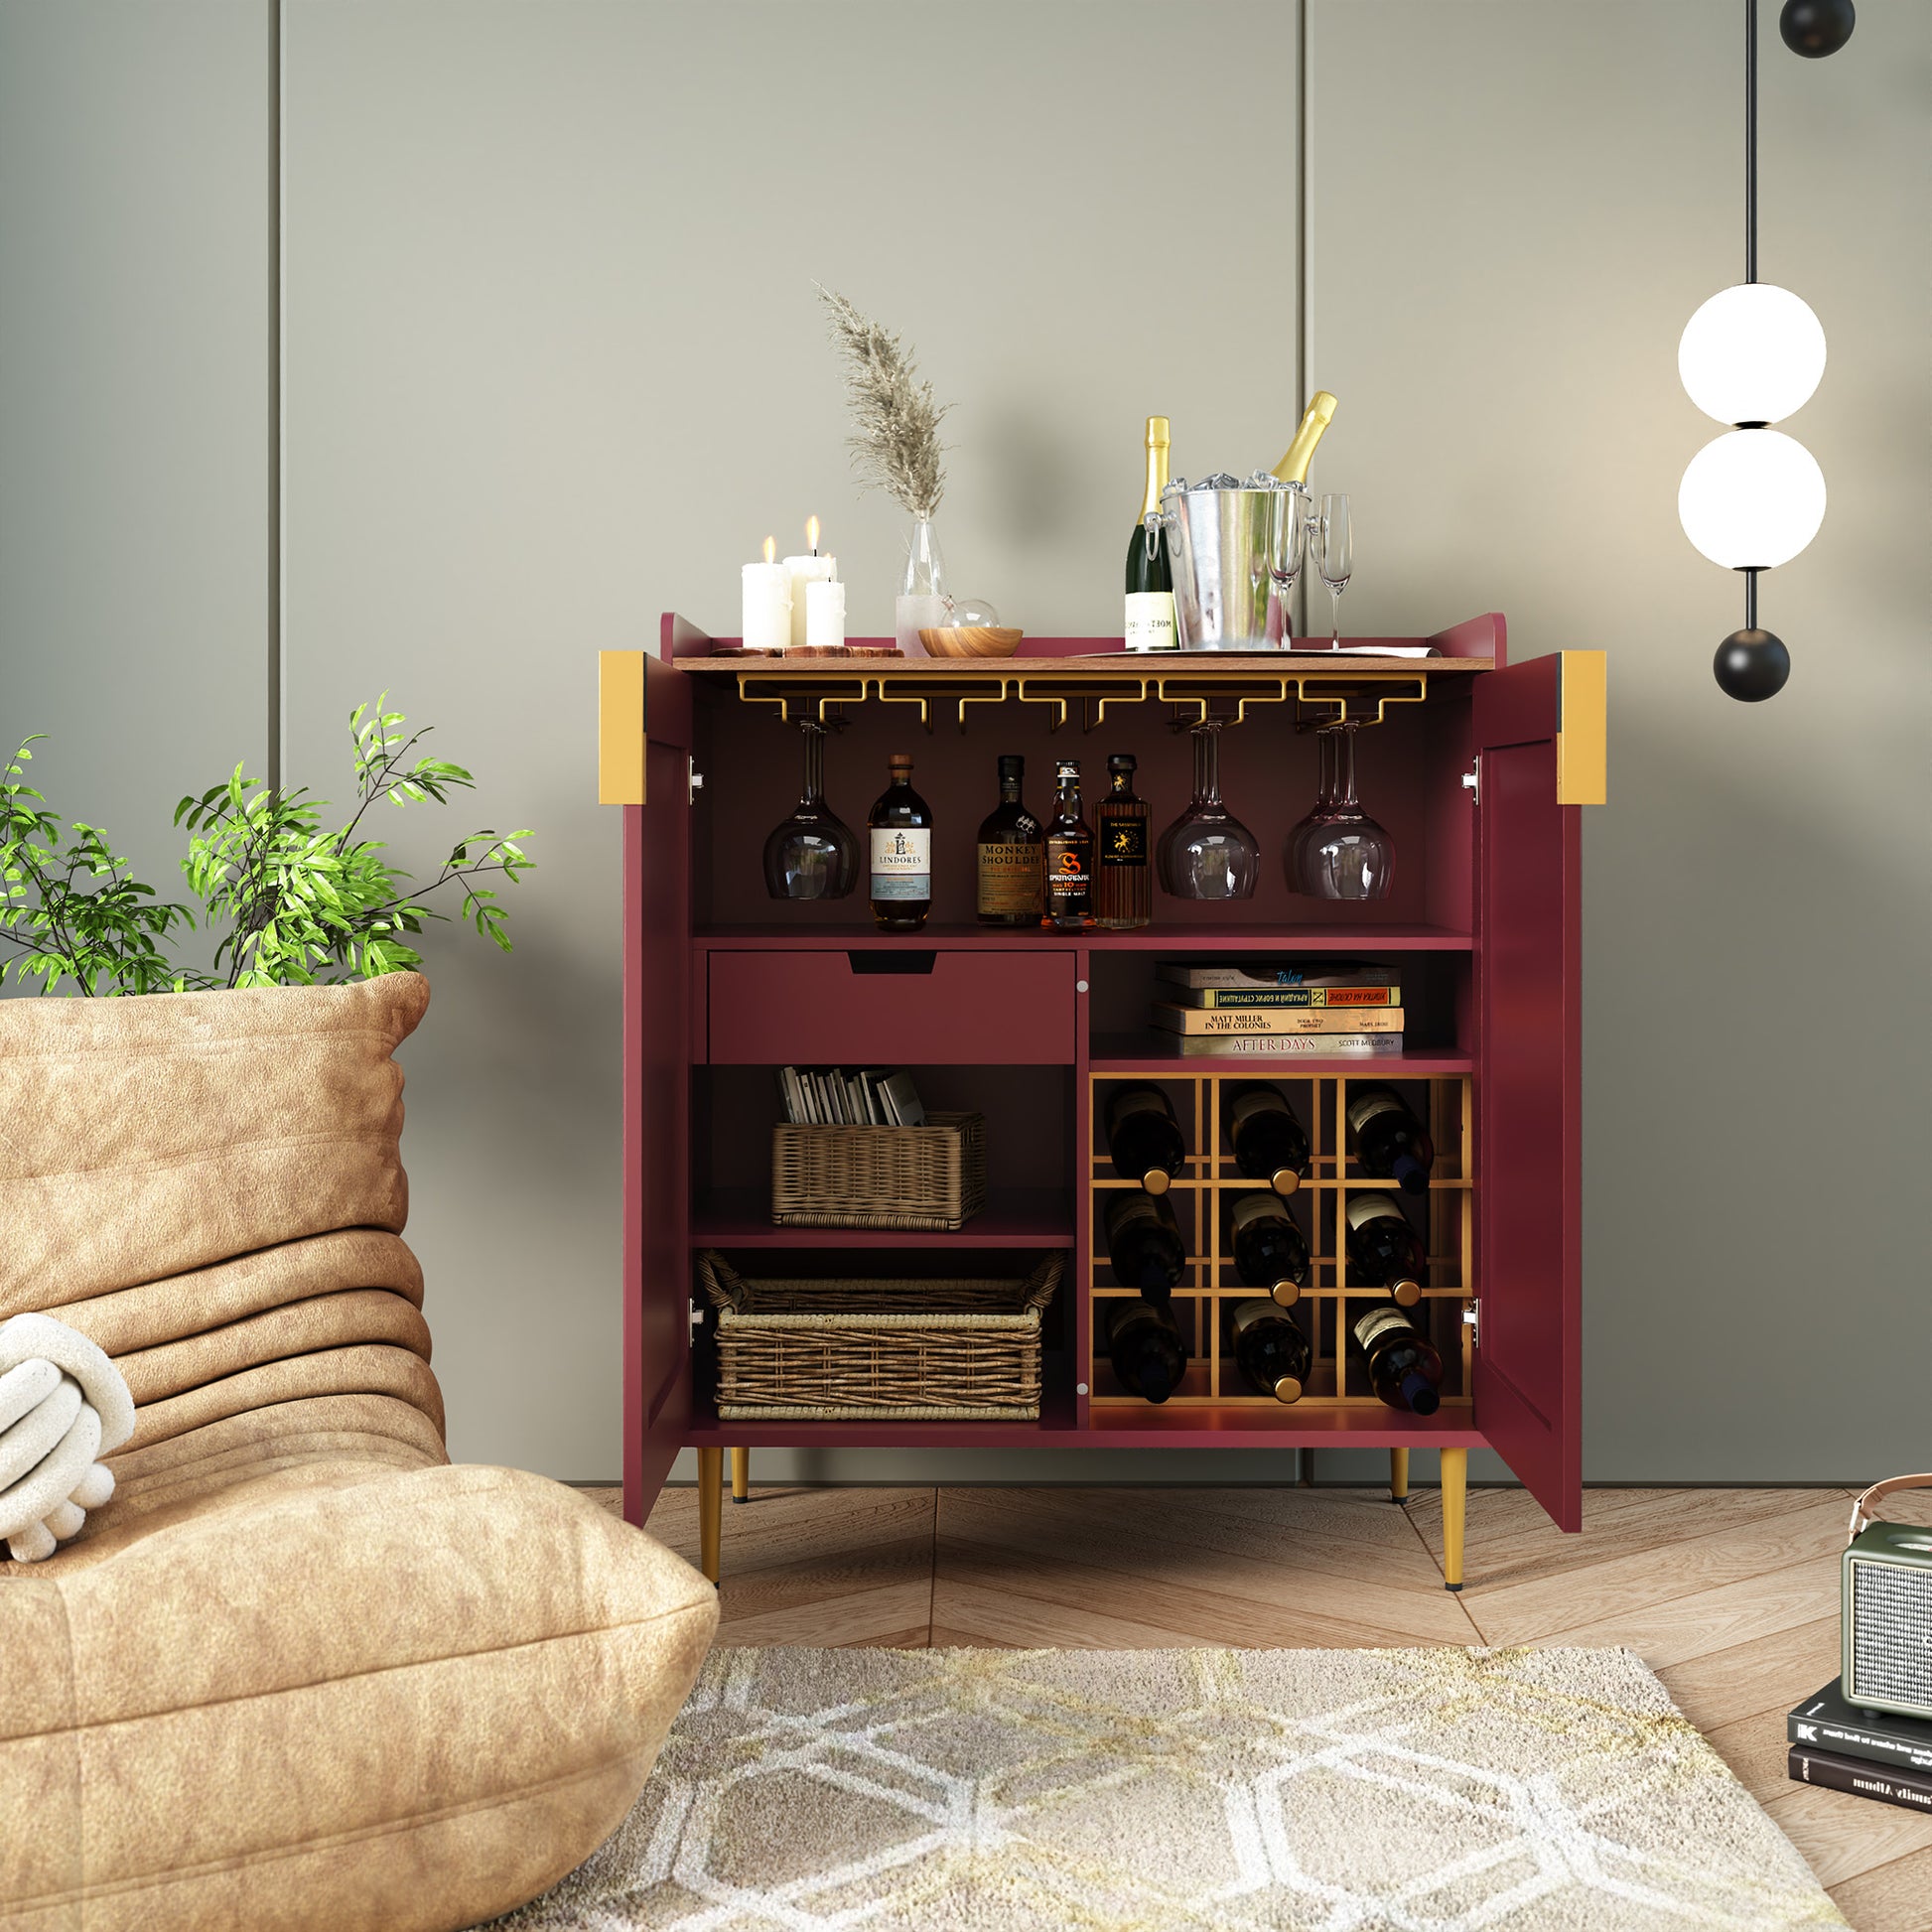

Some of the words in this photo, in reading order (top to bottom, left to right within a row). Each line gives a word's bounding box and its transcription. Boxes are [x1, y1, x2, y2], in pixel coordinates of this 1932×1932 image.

[985, 845, 1036, 854] MONKEY
[1232, 1038, 1276, 1051] AFTER
[1280, 1037, 1316, 1050] DAYS
